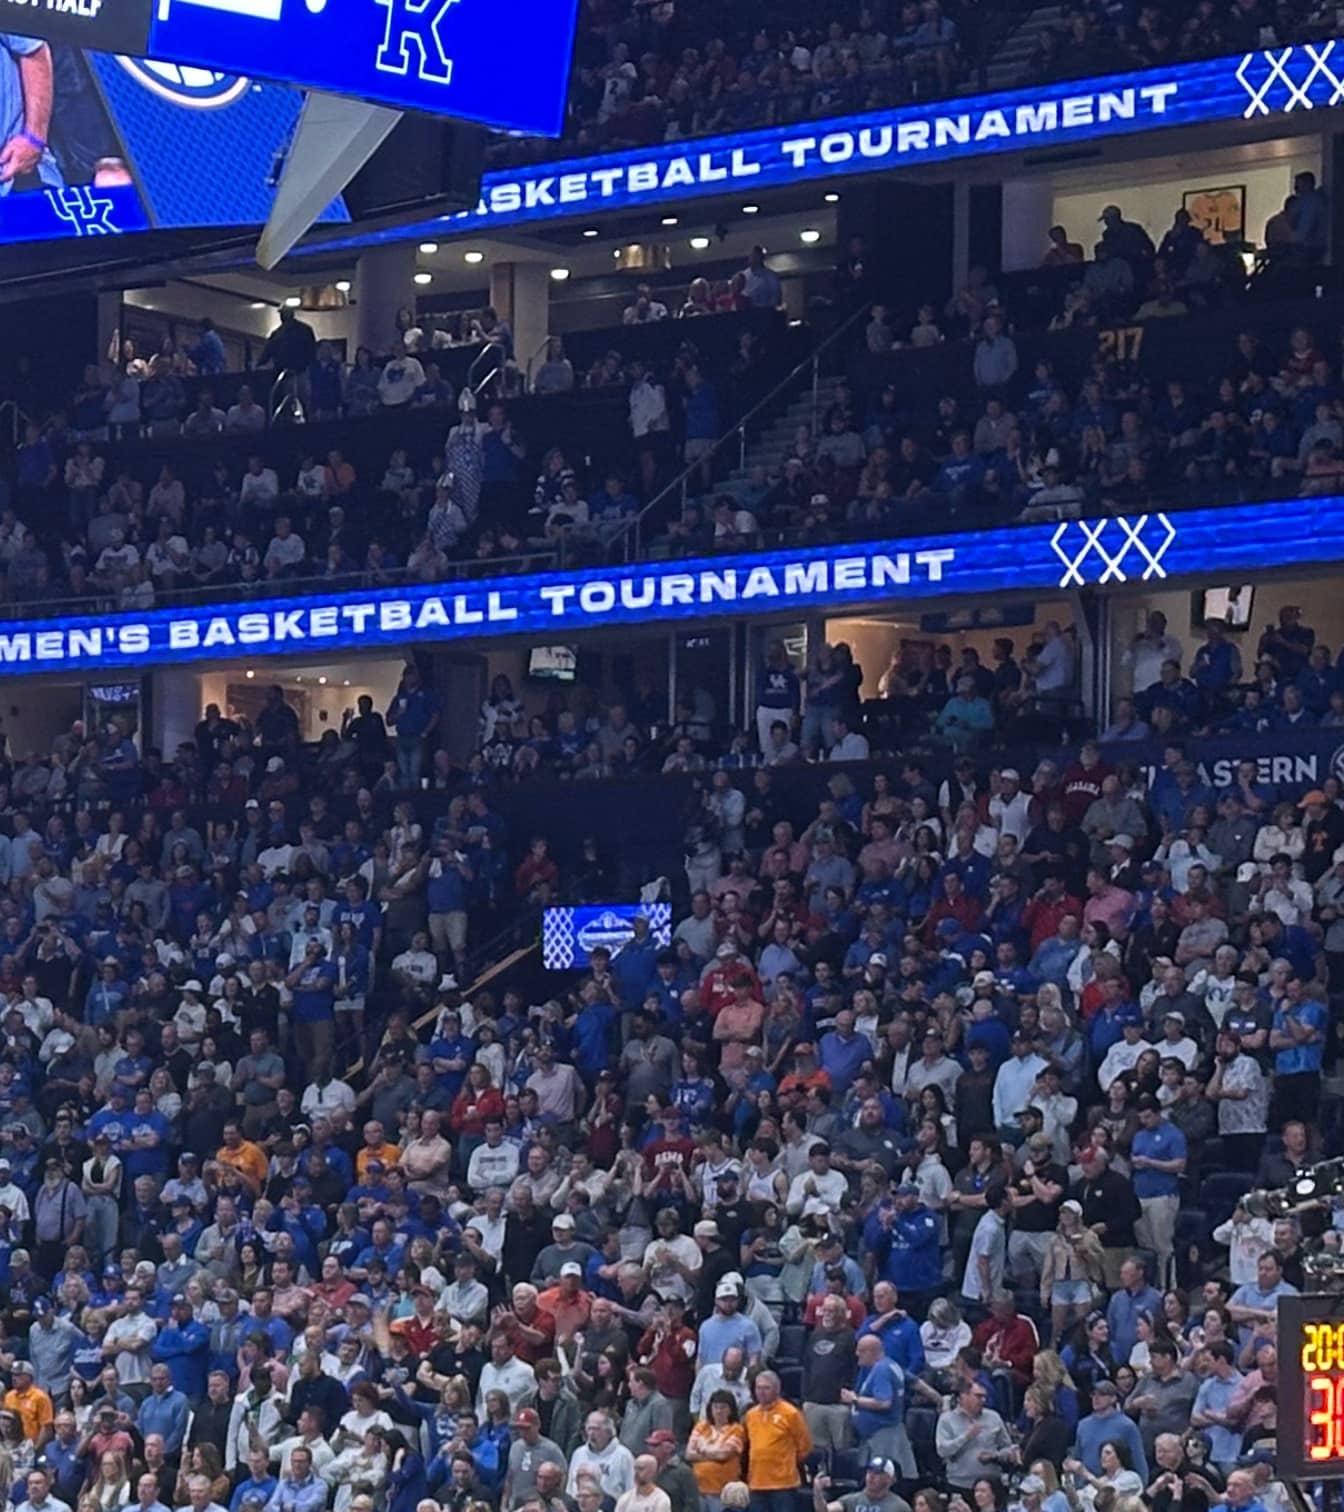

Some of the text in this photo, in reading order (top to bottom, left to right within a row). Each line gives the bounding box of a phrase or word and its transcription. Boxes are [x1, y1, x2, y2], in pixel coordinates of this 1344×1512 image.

[439, 83, 1179, 222] SKETBALL TOURNAMENT
[168, 591, 519, 649] BASKETBALL
[540, 548, 967, 616] TOURNAMENT
[1302, 1324, 1344, 1372] 20:
[1311, 1379, 1344, 1459] 3
